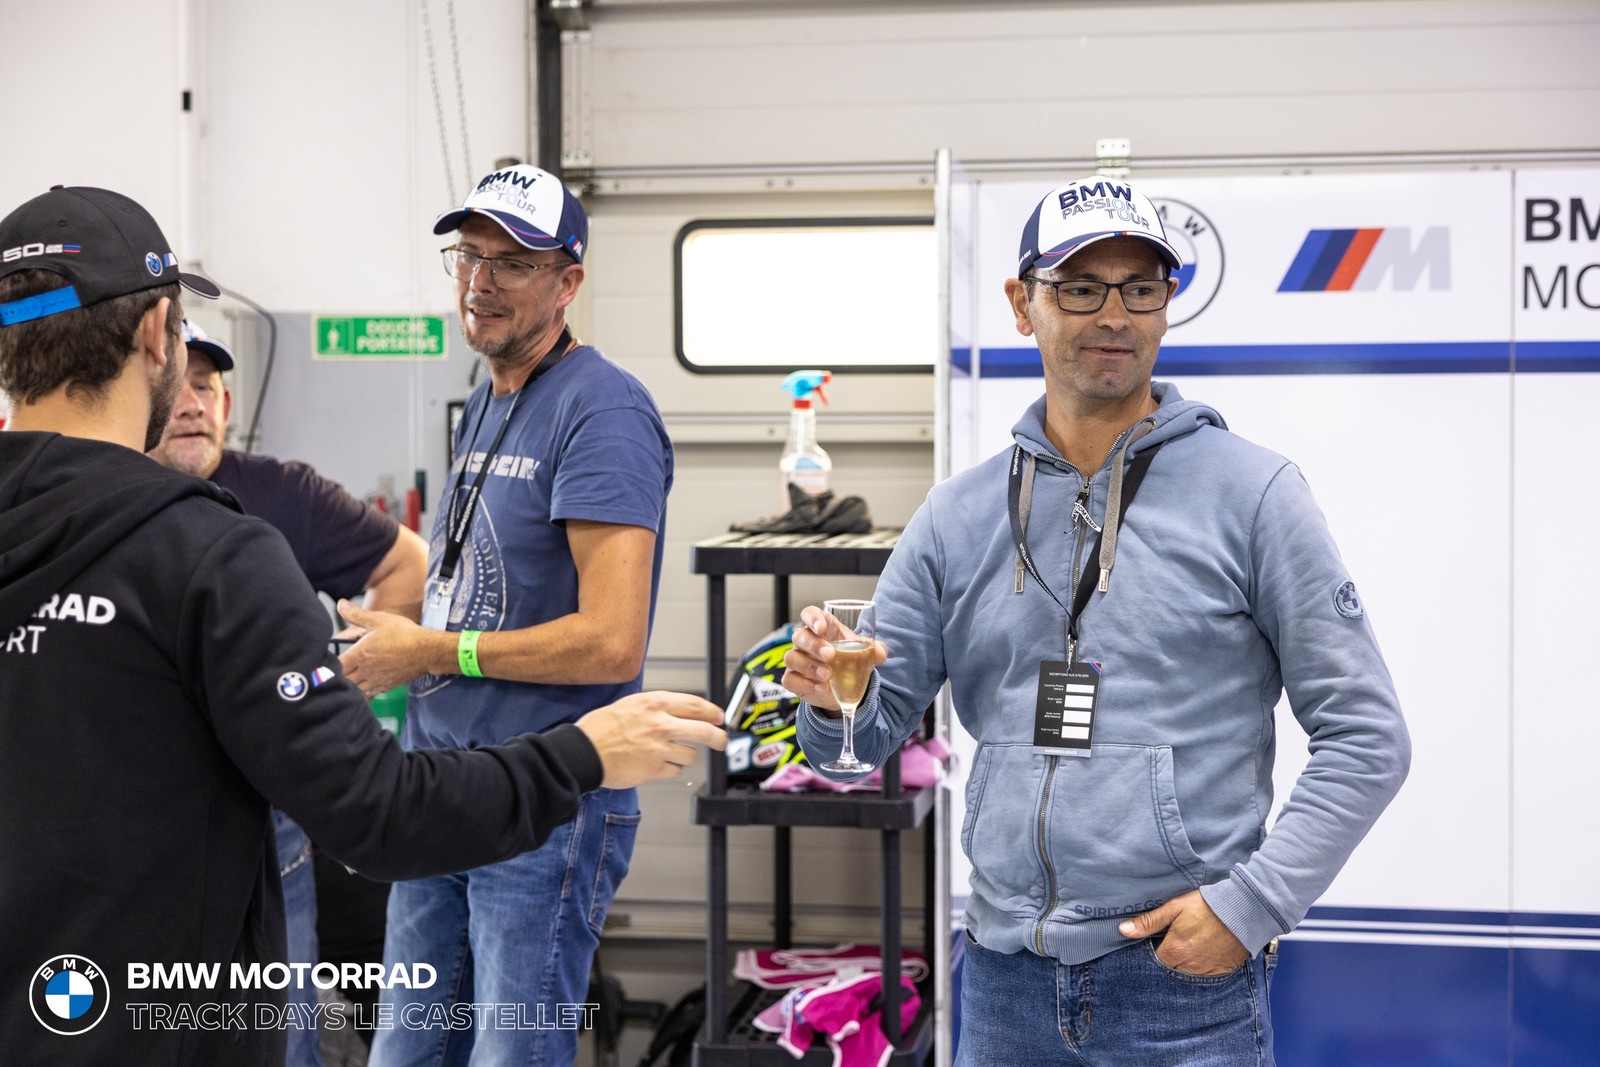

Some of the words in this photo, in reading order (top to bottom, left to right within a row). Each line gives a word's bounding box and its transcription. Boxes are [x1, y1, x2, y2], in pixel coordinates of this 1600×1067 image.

[477, 170, 537, 190] BMW
[1058, 181, 1132, 210] BMW
[3, 242, 45, 263] 50
[479, 538, 499, 618] OLIVER
[33, 592, 116, 625] RAD
[0, 625, 47, 654] RT
[1075, 904, 1120, 918] SPIRIT
[1123, 902, 1142, 914] OF
